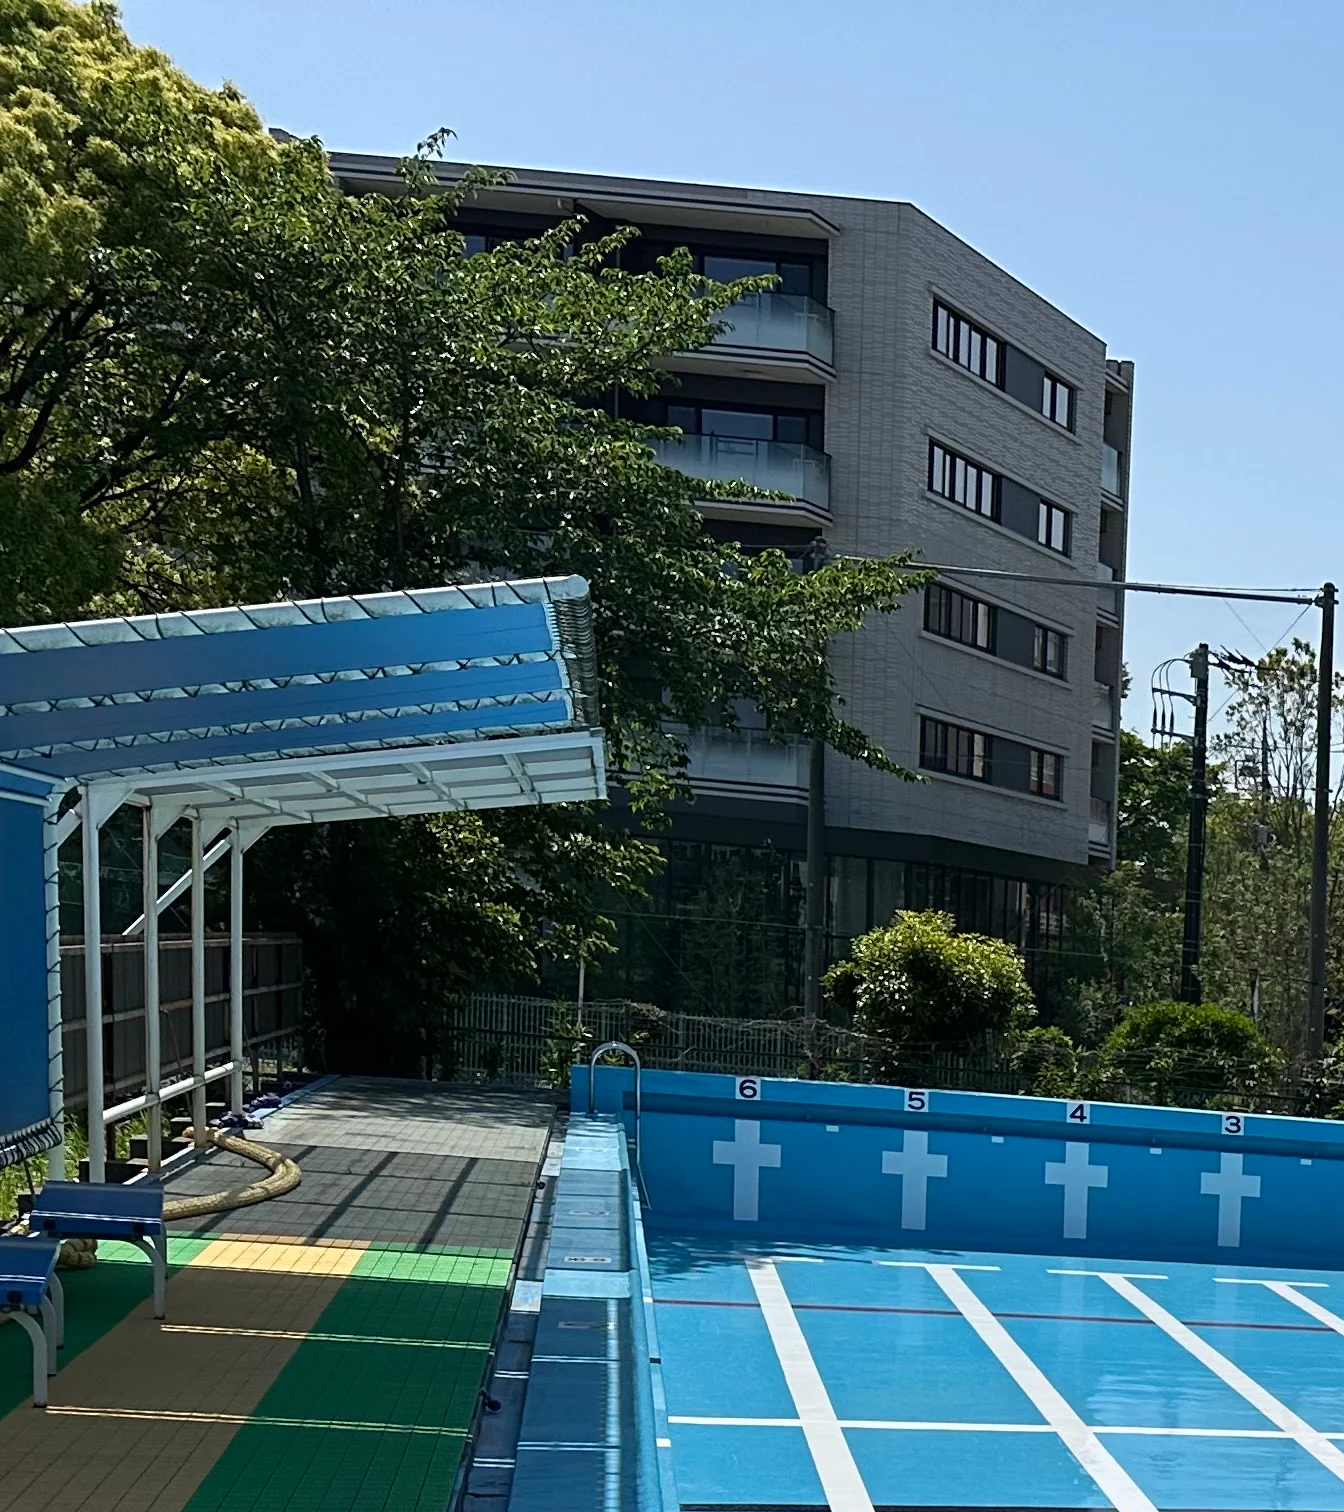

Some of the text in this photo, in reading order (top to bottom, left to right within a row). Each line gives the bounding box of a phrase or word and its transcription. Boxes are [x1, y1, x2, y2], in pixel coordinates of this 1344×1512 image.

[738, 1079, 758, 1099] 6
[907, 1091, 926, 1111] 5
[1069, 1103, 1088, 1123] 4
[1224, 1115, 1242, 1134] 3
